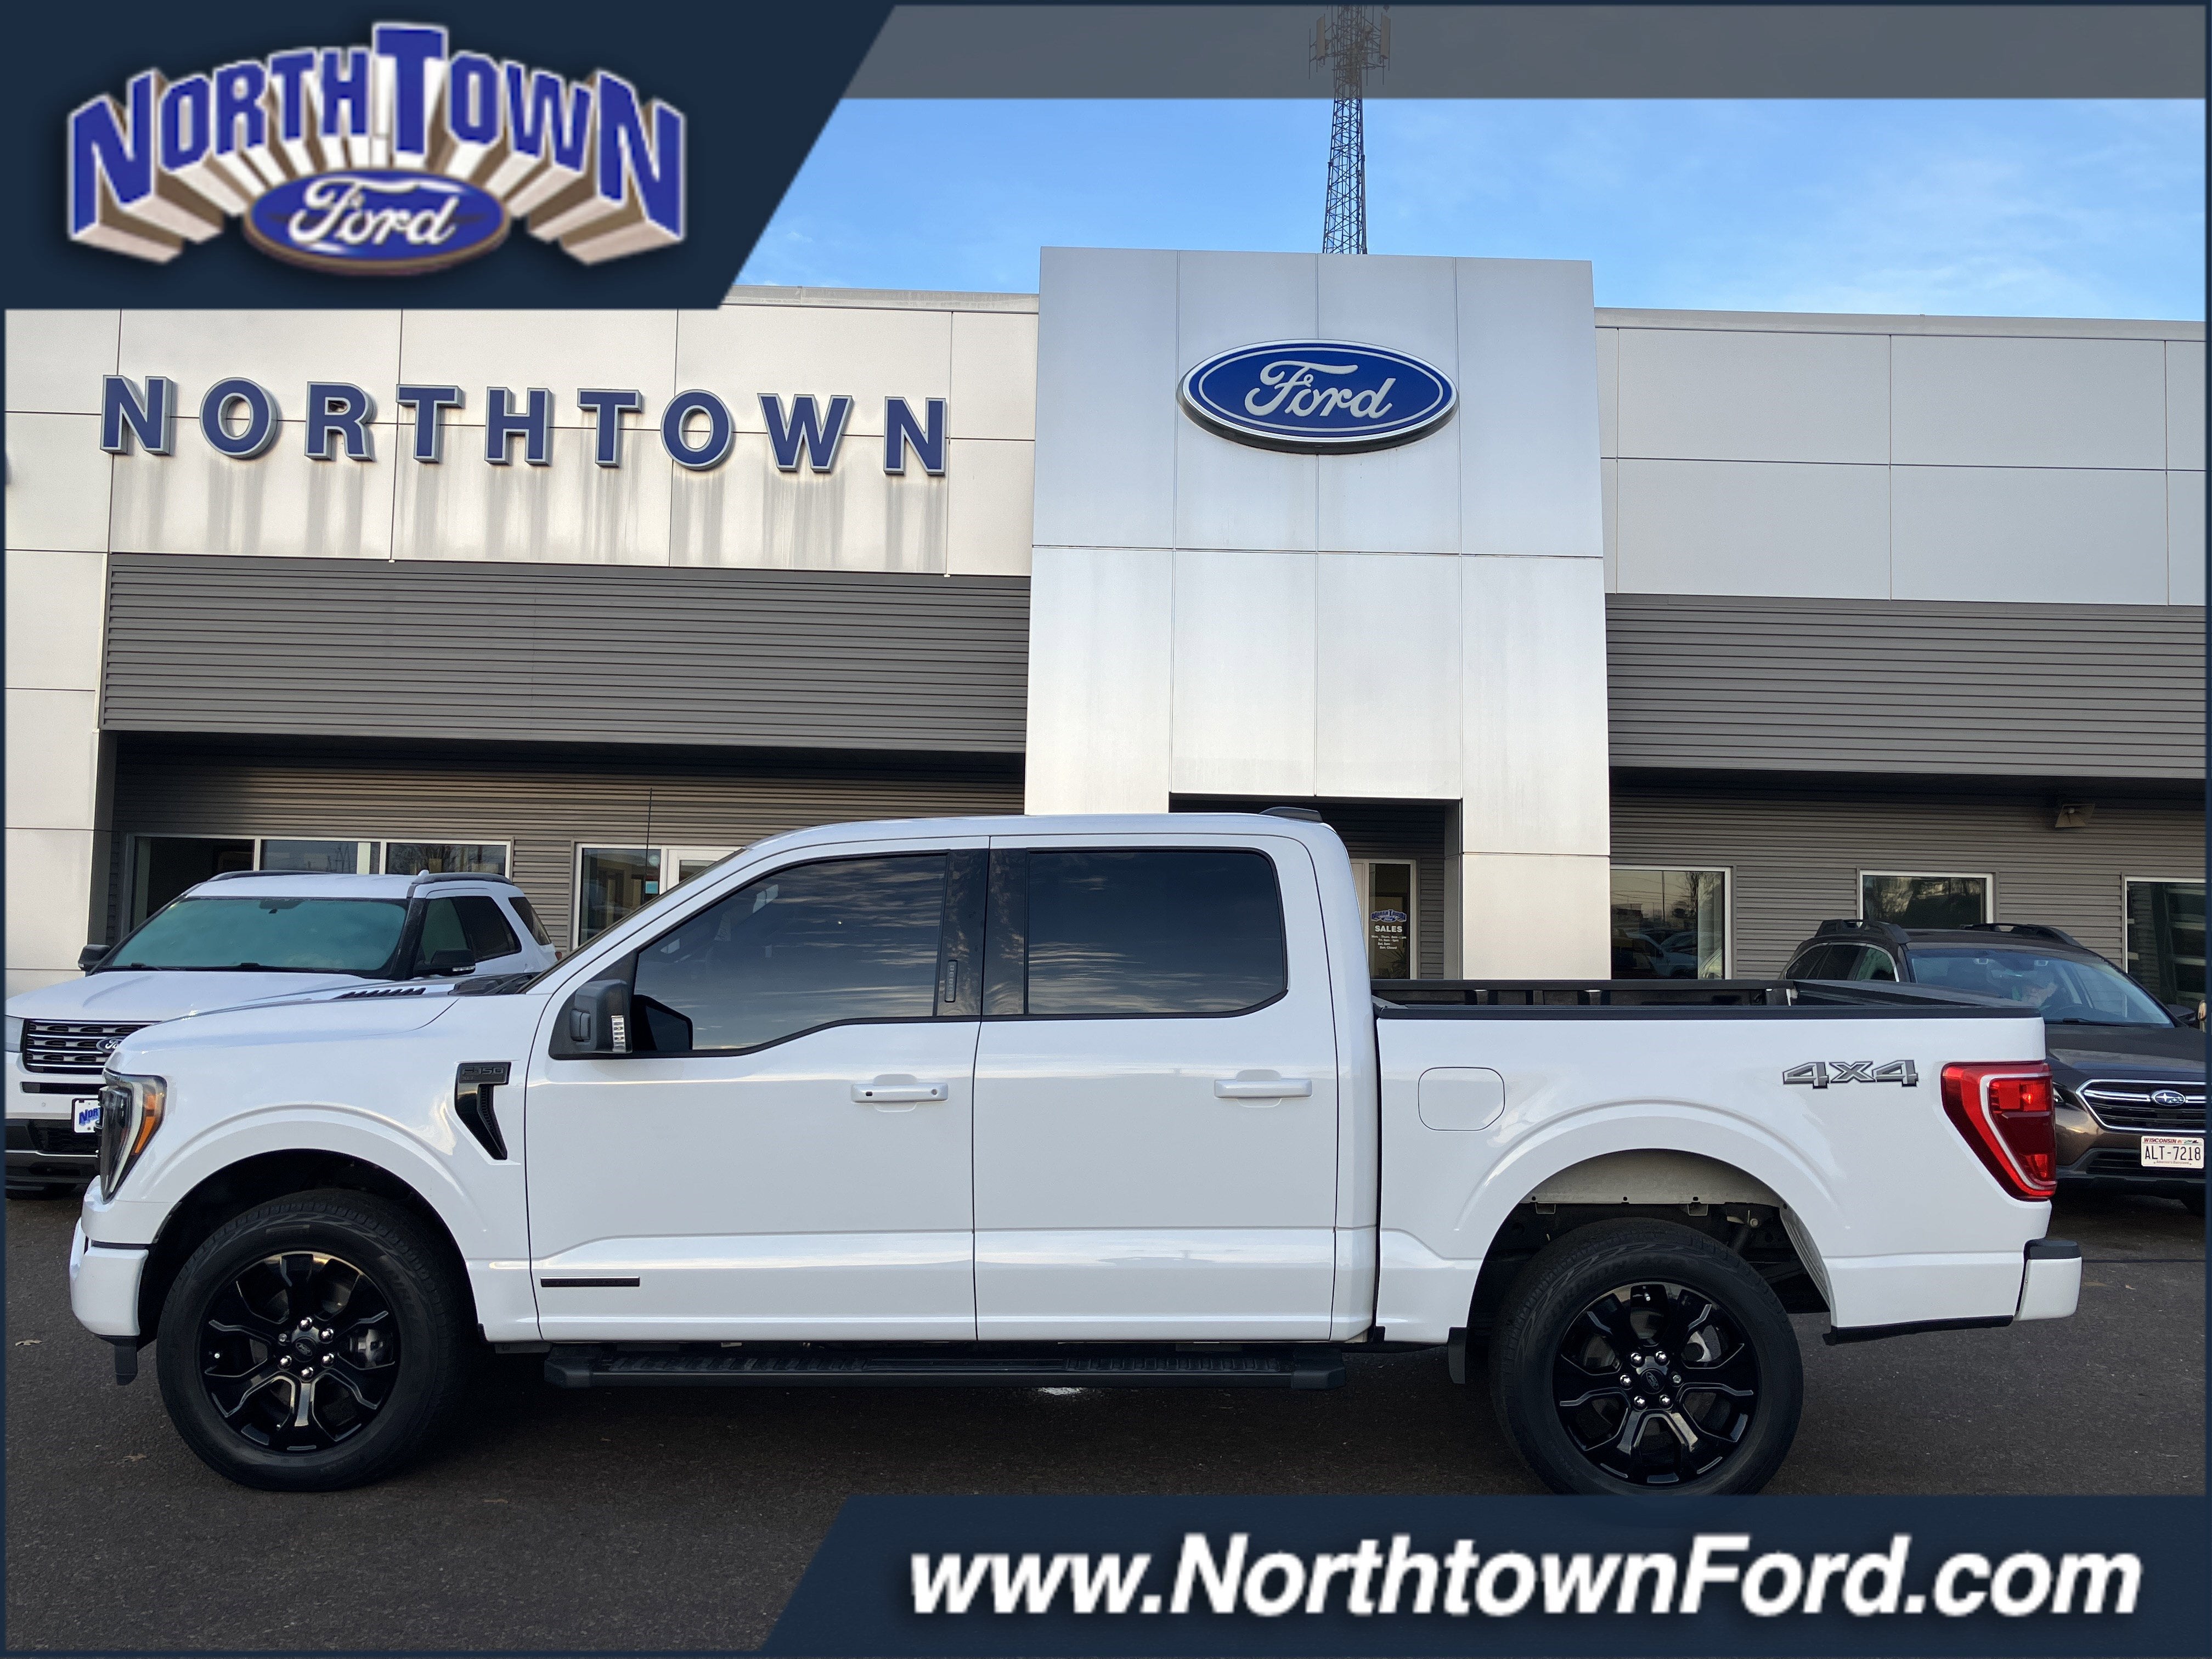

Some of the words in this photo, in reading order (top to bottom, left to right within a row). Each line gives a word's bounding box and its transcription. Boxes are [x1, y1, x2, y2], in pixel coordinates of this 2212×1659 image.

[1244, 360, 1396, 419] Ford
[100, 374, 947, 476] NORTHTOWN
[2145, 1146, 2201, 1161] ALT-7218
